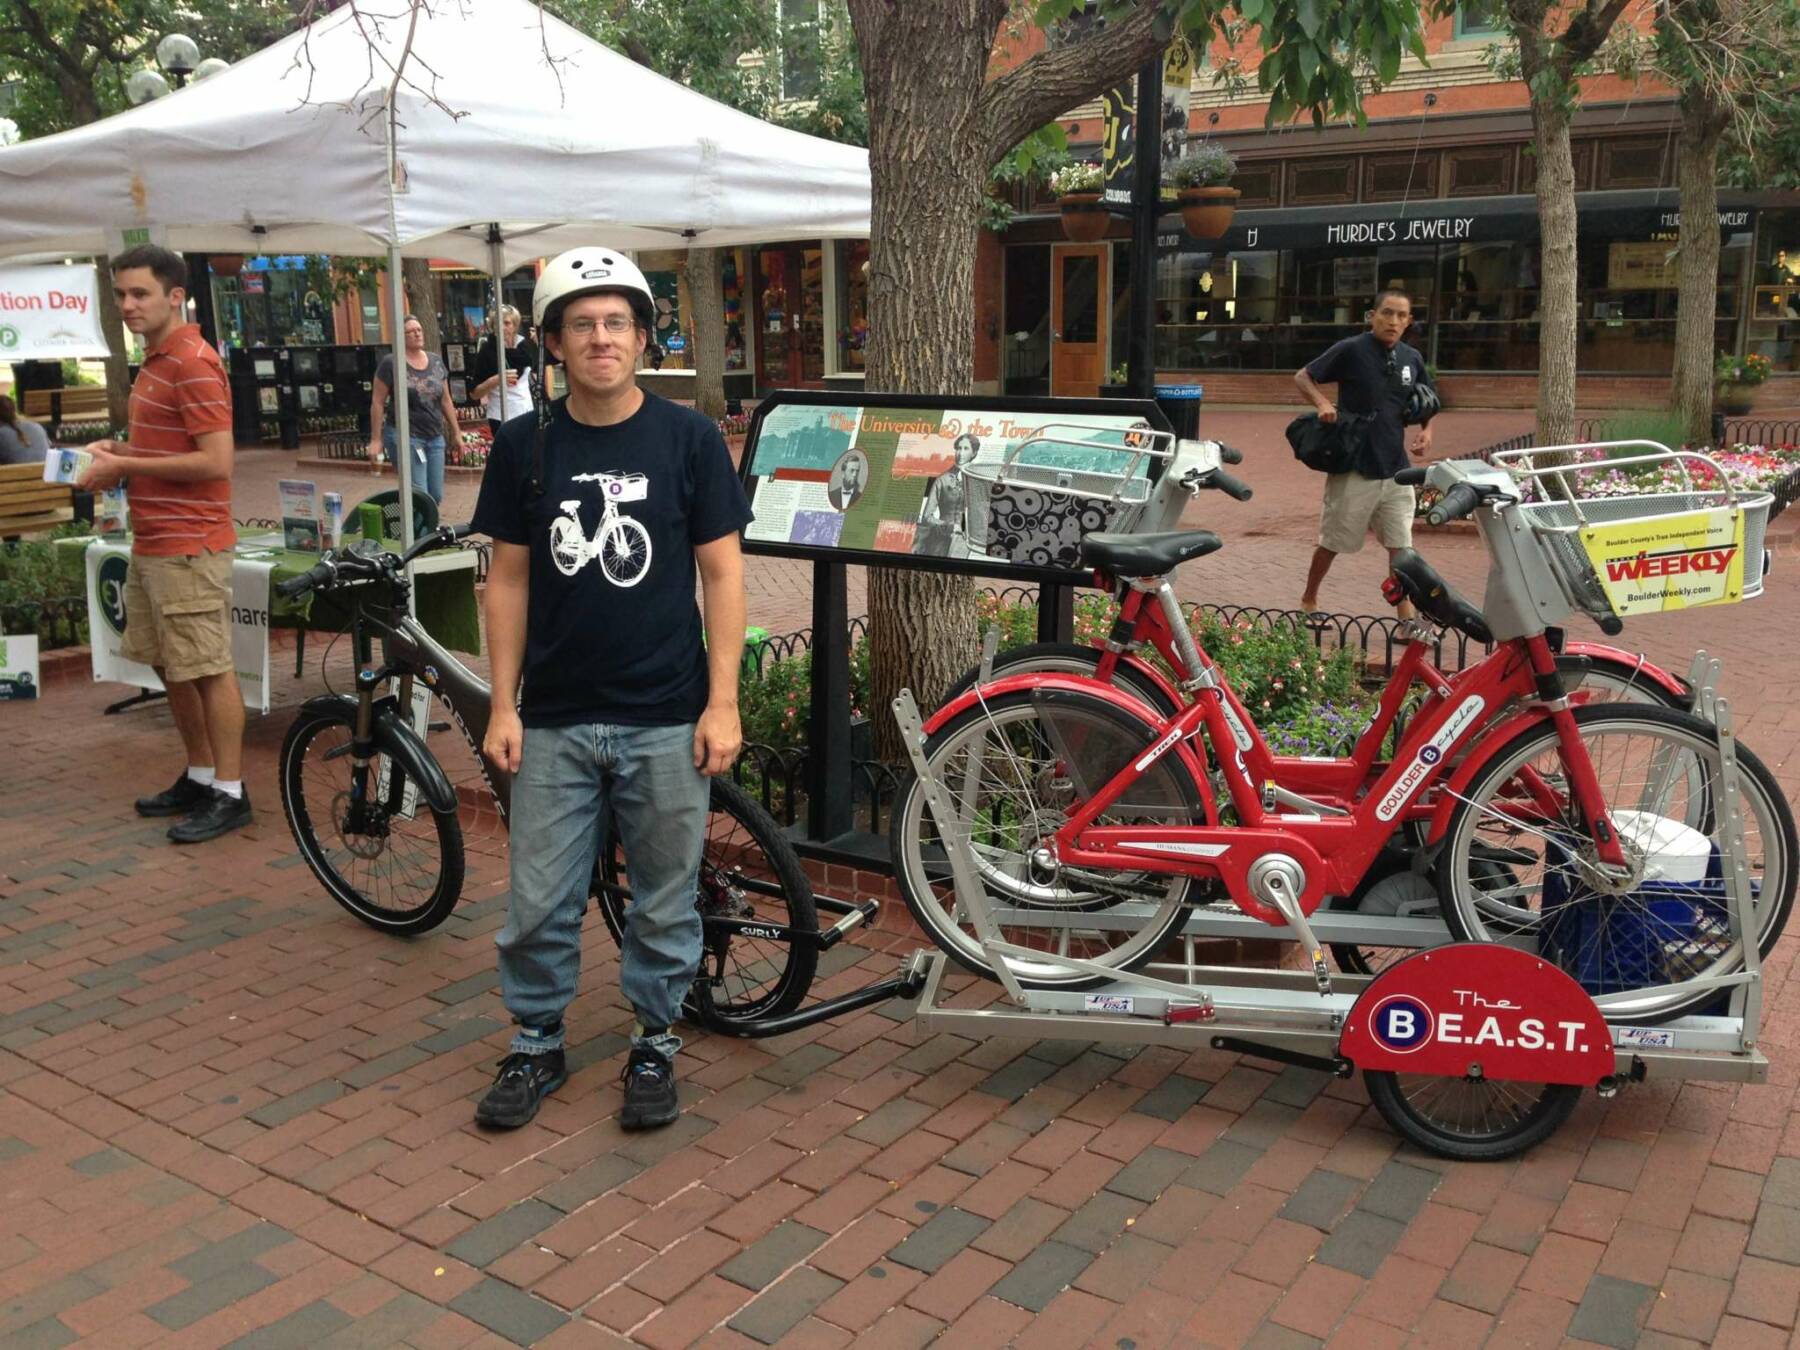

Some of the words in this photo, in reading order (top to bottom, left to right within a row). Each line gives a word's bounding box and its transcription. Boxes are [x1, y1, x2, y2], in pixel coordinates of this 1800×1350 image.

[1328, 222, 1396, 244] HURDLE'S
[1403, 218, 1474, 241] JEWELRY
[48, 290, 88, 314] Day
[860, 415, 936, 440] University
[968, 418, 993, 438] the
[1669, 530, 1706, 540] Independent
[1606, 548, 1738, 582] WEEKLY
[1627, 586, 1711, 602] BoulderWeekly.com
[1380, 763, 1426, 817] BOULDER
[740, 926, 781, 939] SURLY
[1453, 990, 1522, 1010] The
